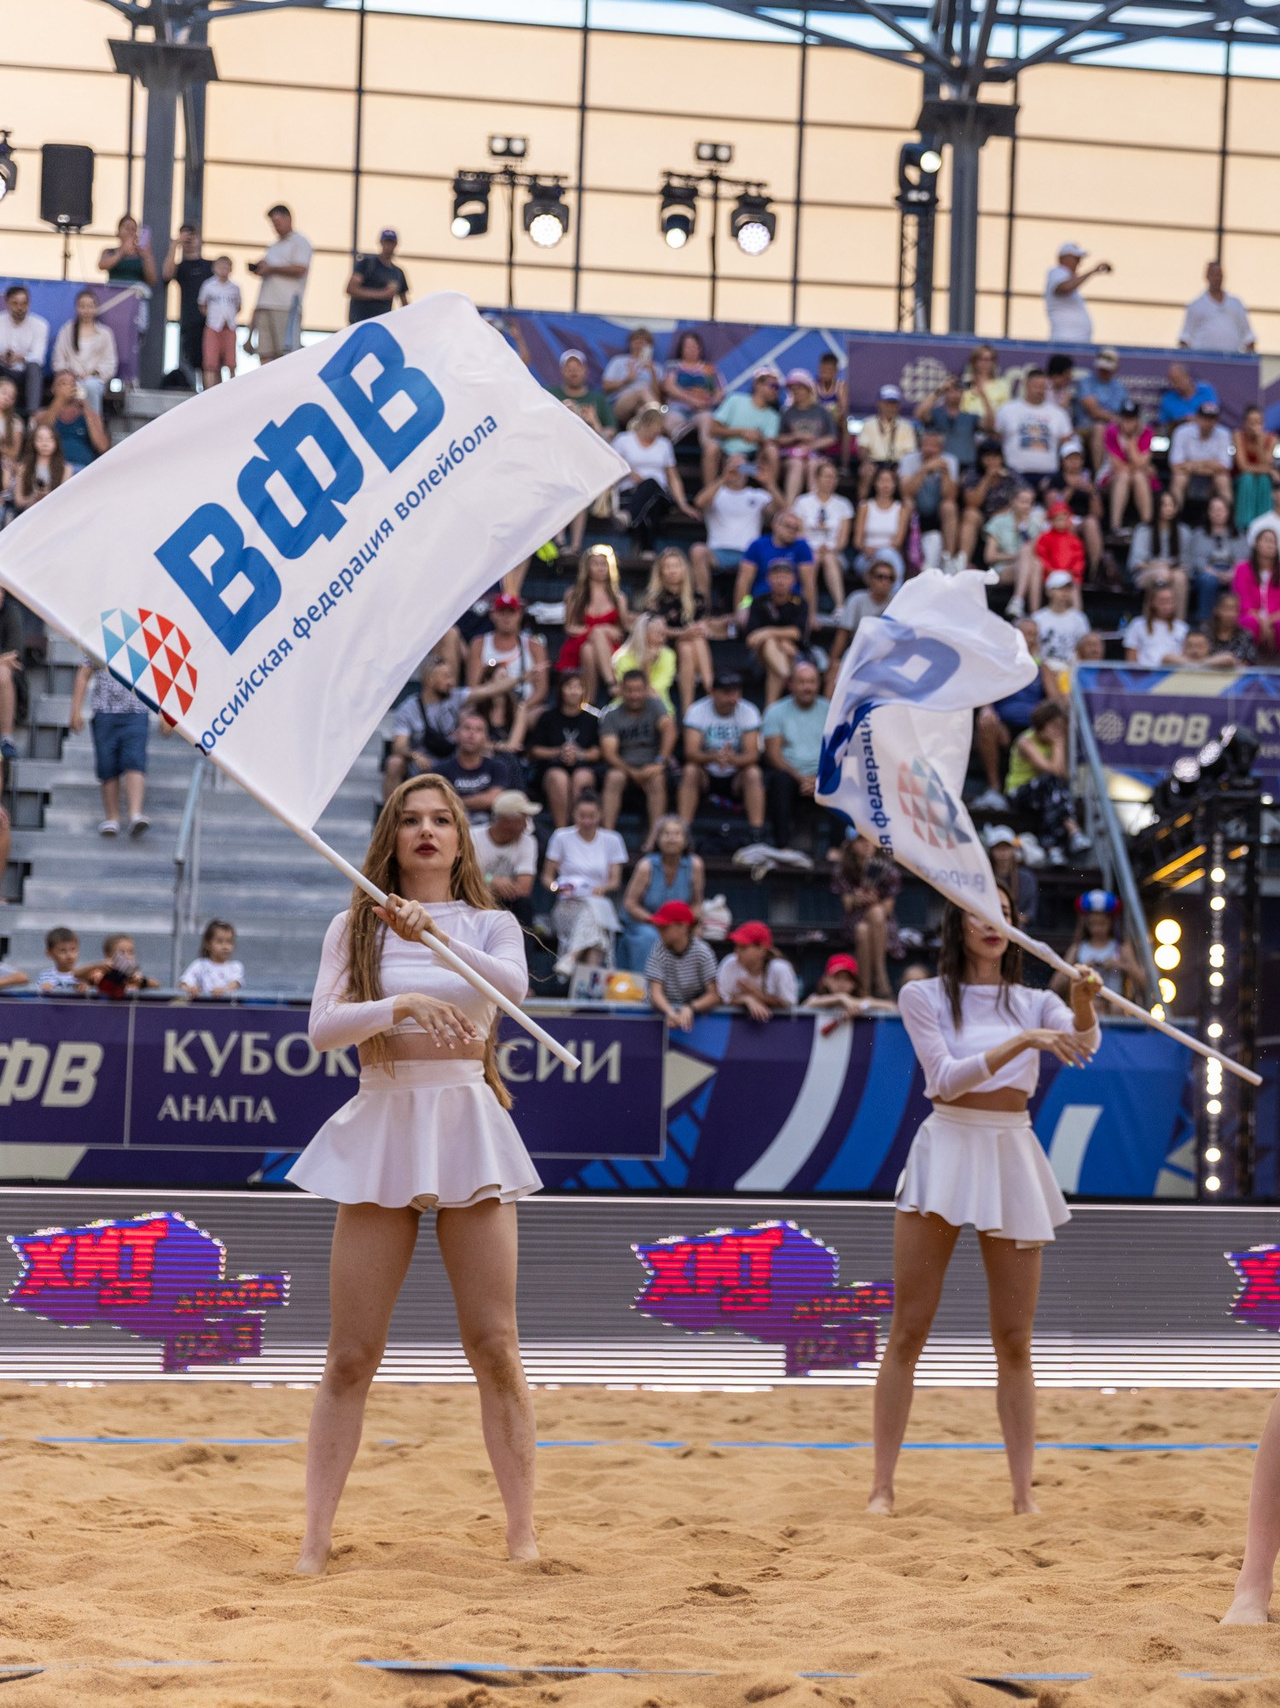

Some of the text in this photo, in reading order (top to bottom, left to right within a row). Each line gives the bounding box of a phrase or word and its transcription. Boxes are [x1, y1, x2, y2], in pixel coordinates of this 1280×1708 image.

[154, 322, 445, 655] ВФВ
[293, 518, 394, 639] федерация
[394, 415, 498, 521] волейбола
[1125, 711, 1211, 746] ВФВ
[860, 711, 891, 829] федераци
[0, 1038, 104, 1108] ФВ
[163, 1029, 622, 1084] КУБОК СИИ
[157, 1094, 277, 1123] АНАПА
